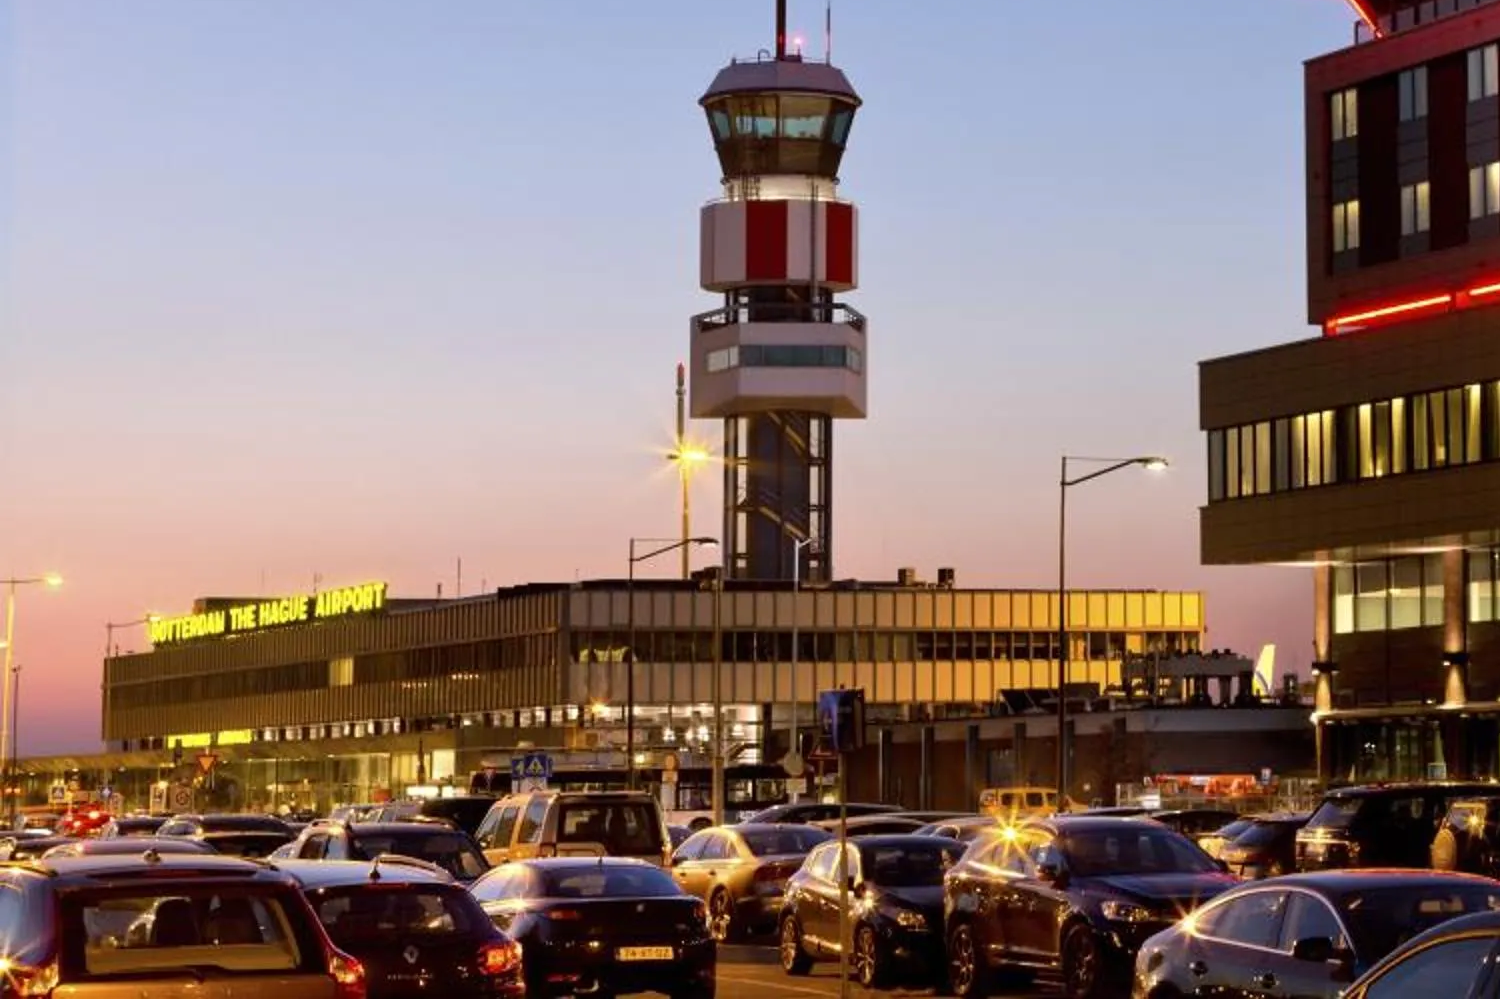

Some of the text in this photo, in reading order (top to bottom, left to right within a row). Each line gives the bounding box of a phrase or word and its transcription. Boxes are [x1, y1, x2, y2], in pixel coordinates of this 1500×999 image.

[229, 605, 257, 631] THE
[259, 595, 308, 626] HAGUE
[315, 583, 385, 617] AIRPORT
